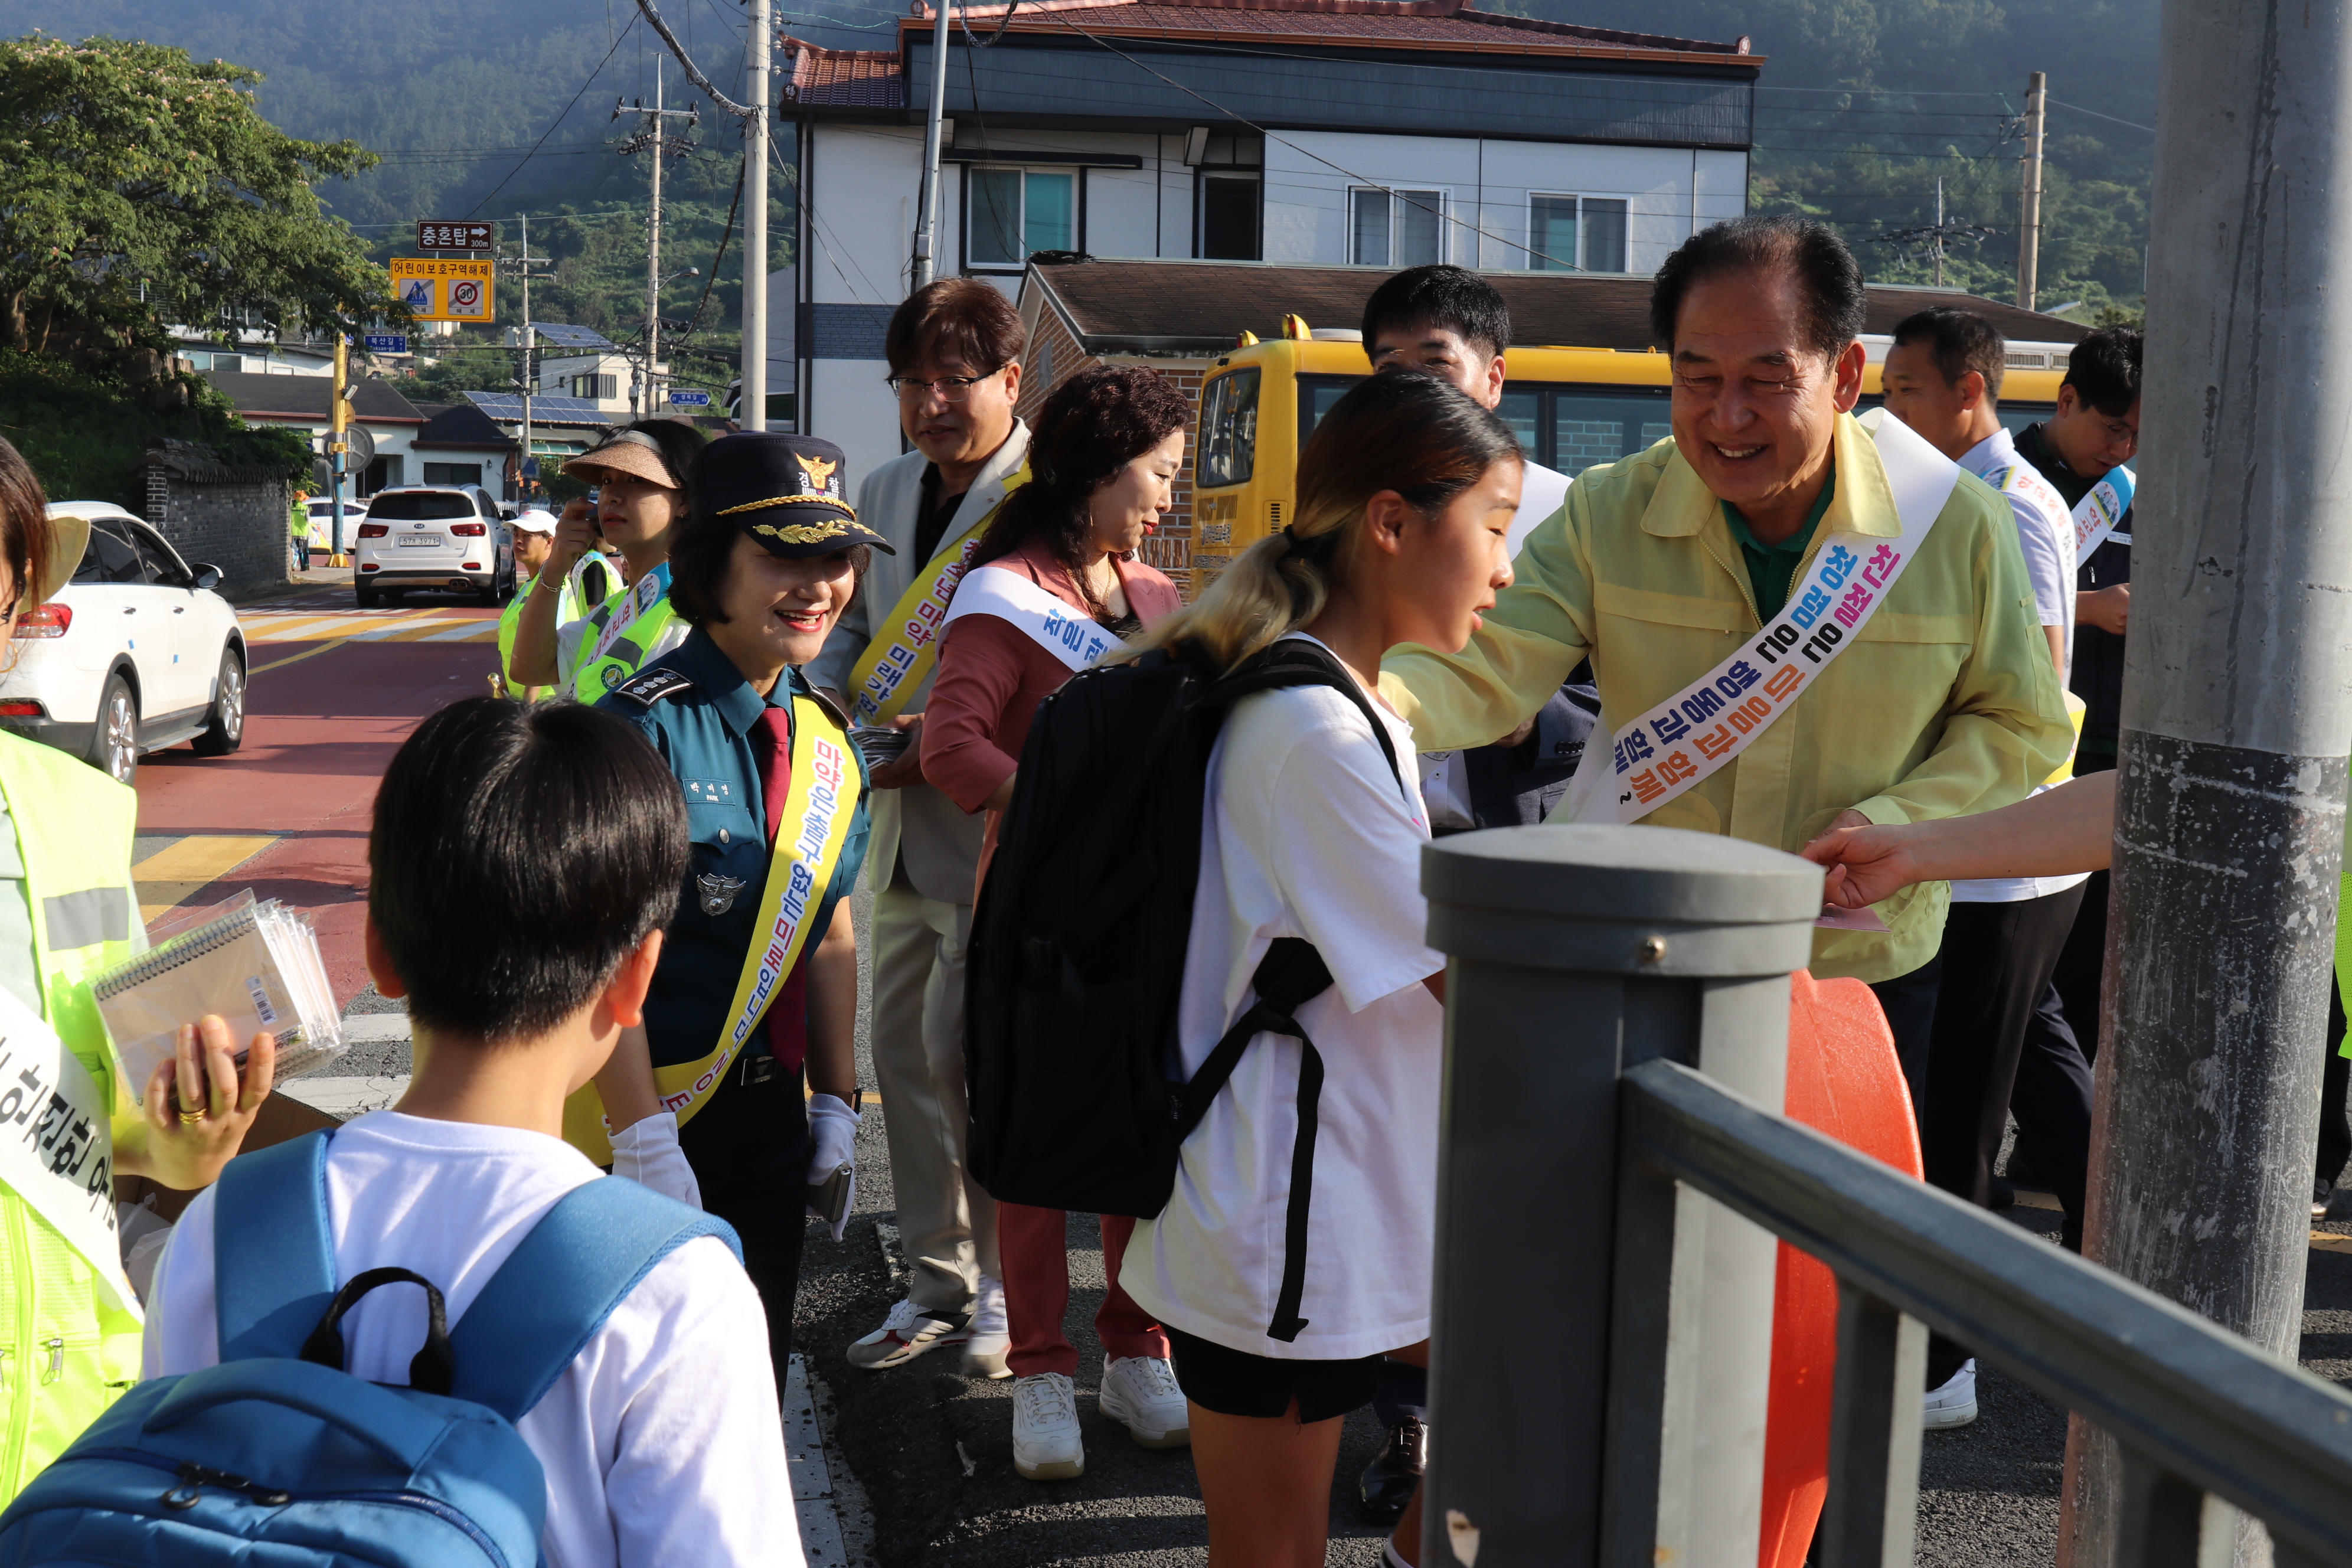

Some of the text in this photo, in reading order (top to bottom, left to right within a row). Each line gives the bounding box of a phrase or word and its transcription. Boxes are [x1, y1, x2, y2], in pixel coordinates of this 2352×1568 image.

[422, 227, 468, 246] 충혼탑
[460, 288, 473, 299] 30
[371, 337, 394, 345] 북산길
[2076, 506, 2102, 551] 학교폭
[907, 602, 943, 646] 마약
[1756, 545, 1858, 664] 청렴은
[1801, 544, 1900, 664] 친절은
[1043, 609, 1085, 652] 작은
[868, 645, 915, 700] 미래가
[1649, 661, 1761, 745] 행동과
[1693, 664, 1805, 759] 마음과
[697, 1053, 727, 1092] NO
[0, 1064, 96, 1177] 안전한
